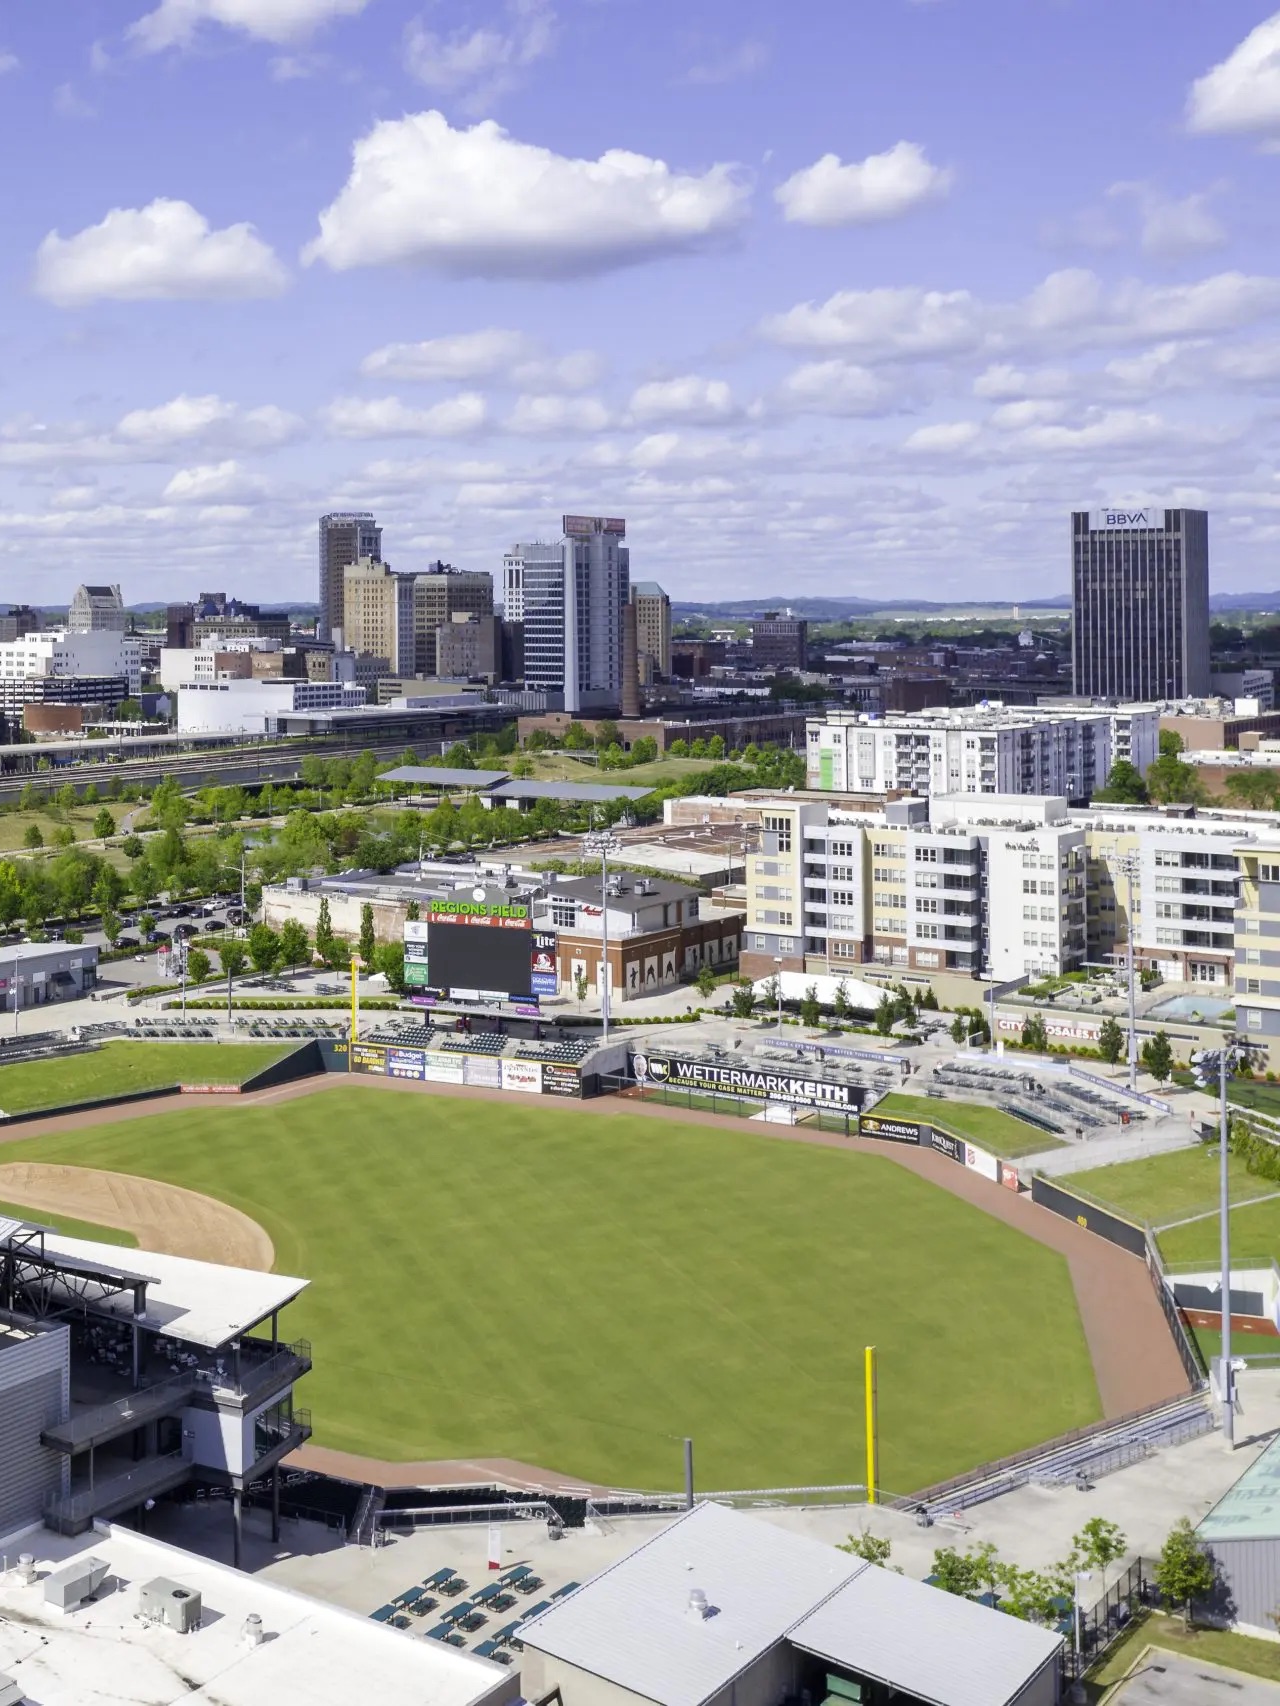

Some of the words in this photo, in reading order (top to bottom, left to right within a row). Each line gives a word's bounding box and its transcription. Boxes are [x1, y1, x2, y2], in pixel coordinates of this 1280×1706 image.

[1106, 513, 1147, 525] BBVA
[431, 901, 487, 916] REGIONS
[489, 904, 527, 919] FIELD
[535, 934, 555, 948] Lite
[334, 1044, 348, 1052] 320
[398, 1050, 423, 1060] Budget
[668, 1077, 698, 1087] BECAUSE
[699, 1081, 717, 1090] YOUR
[718, 1085, 735, 1093] CASE
[736, 1087, 767, 1098] MATTERS
[880, 1123, 919, 1136] ANDREWS
